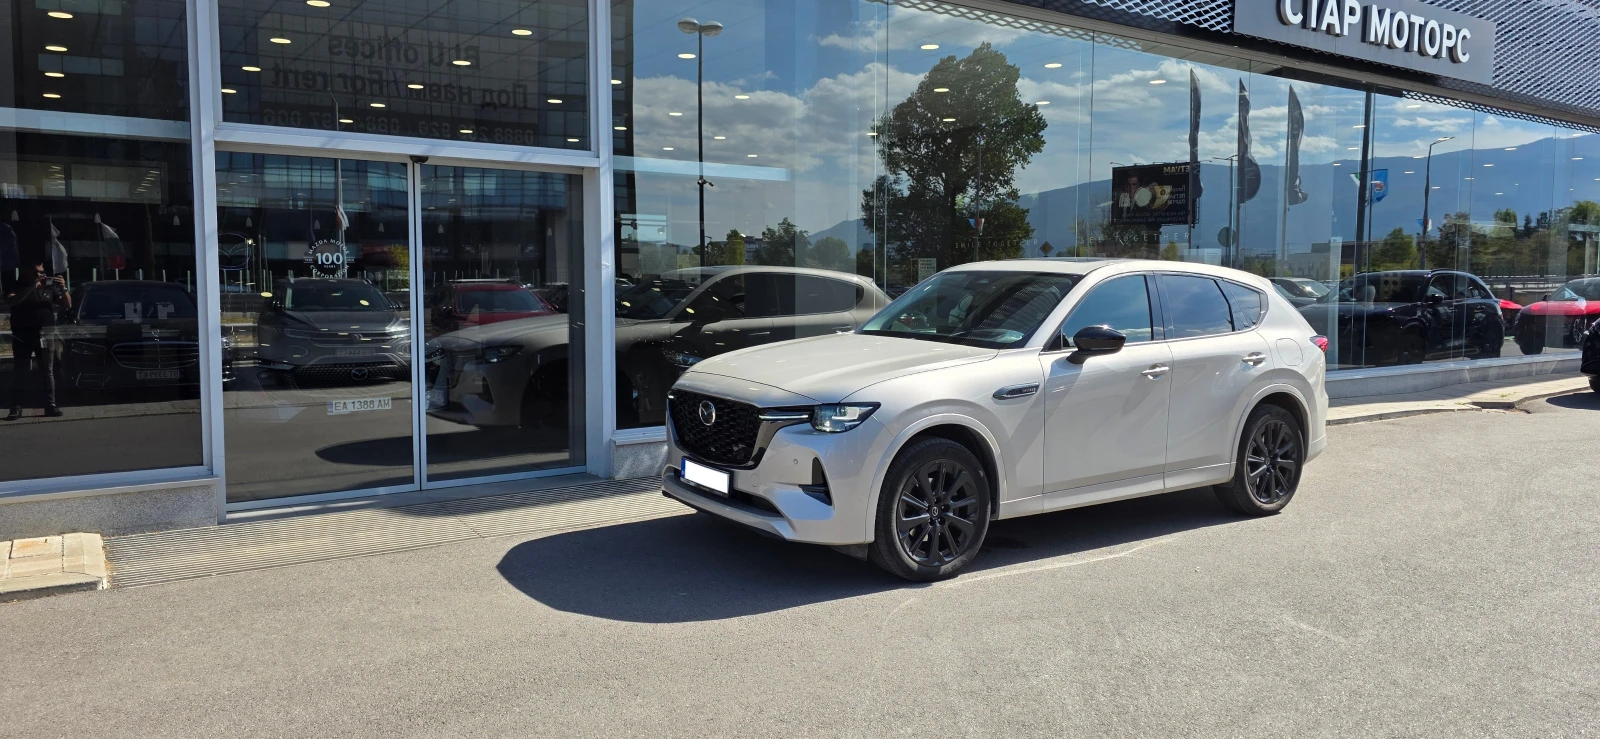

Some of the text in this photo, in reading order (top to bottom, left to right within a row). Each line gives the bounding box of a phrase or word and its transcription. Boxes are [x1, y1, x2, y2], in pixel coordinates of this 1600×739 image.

[1368, 4, 1471, 63] МОТОРС
[955, 239, 1038, 249] SMILE TOGETHER
[1080, 232, 1189, 244] SEE TOGETHER
[308, 238, 350, 255] MAZDA MOTOR
[315, 252, 343, 265] 100
[309, 264, 350, 279] CORPORATION
[334, 401, 348, 411] EA
[351, 400, 375, 410] 1388
[377, 399, 390, 409] AM
